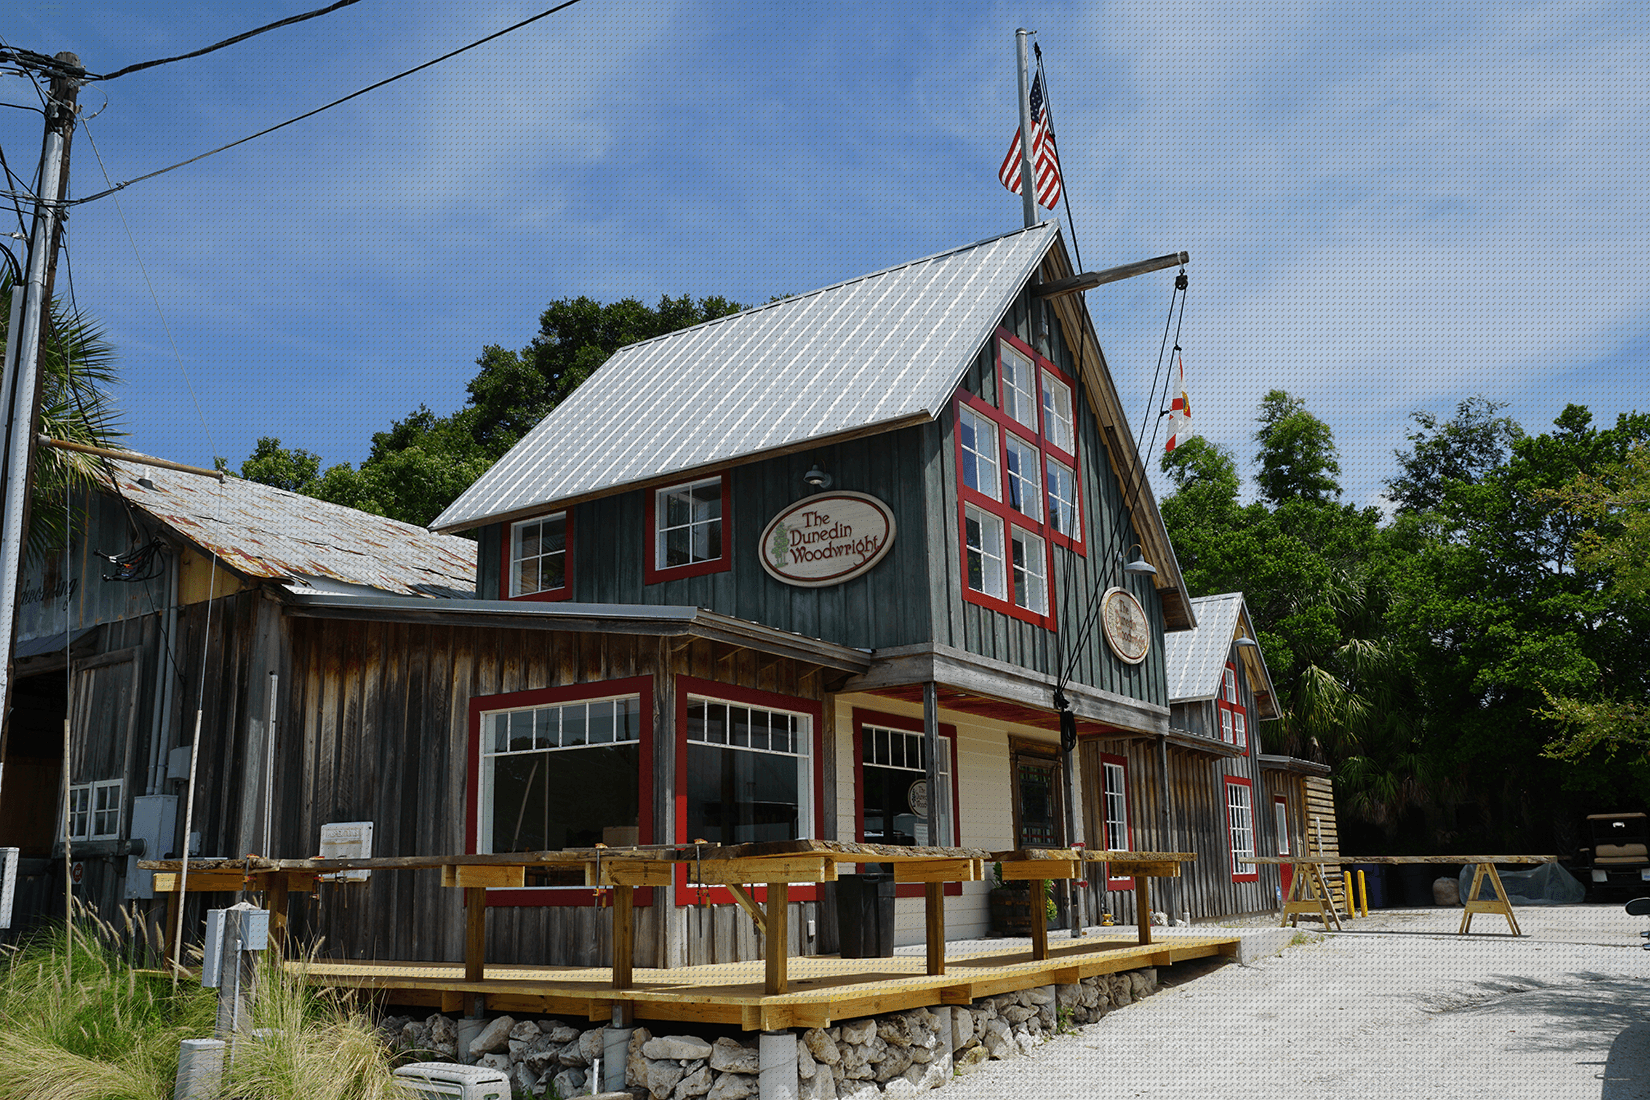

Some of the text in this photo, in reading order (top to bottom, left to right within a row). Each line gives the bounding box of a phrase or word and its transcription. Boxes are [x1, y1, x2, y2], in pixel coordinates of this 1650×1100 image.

[802, 511, 830, 528] The
[790, 521, 852, 547] Dunedin
[790, 535, 880, 563] Woodwright
